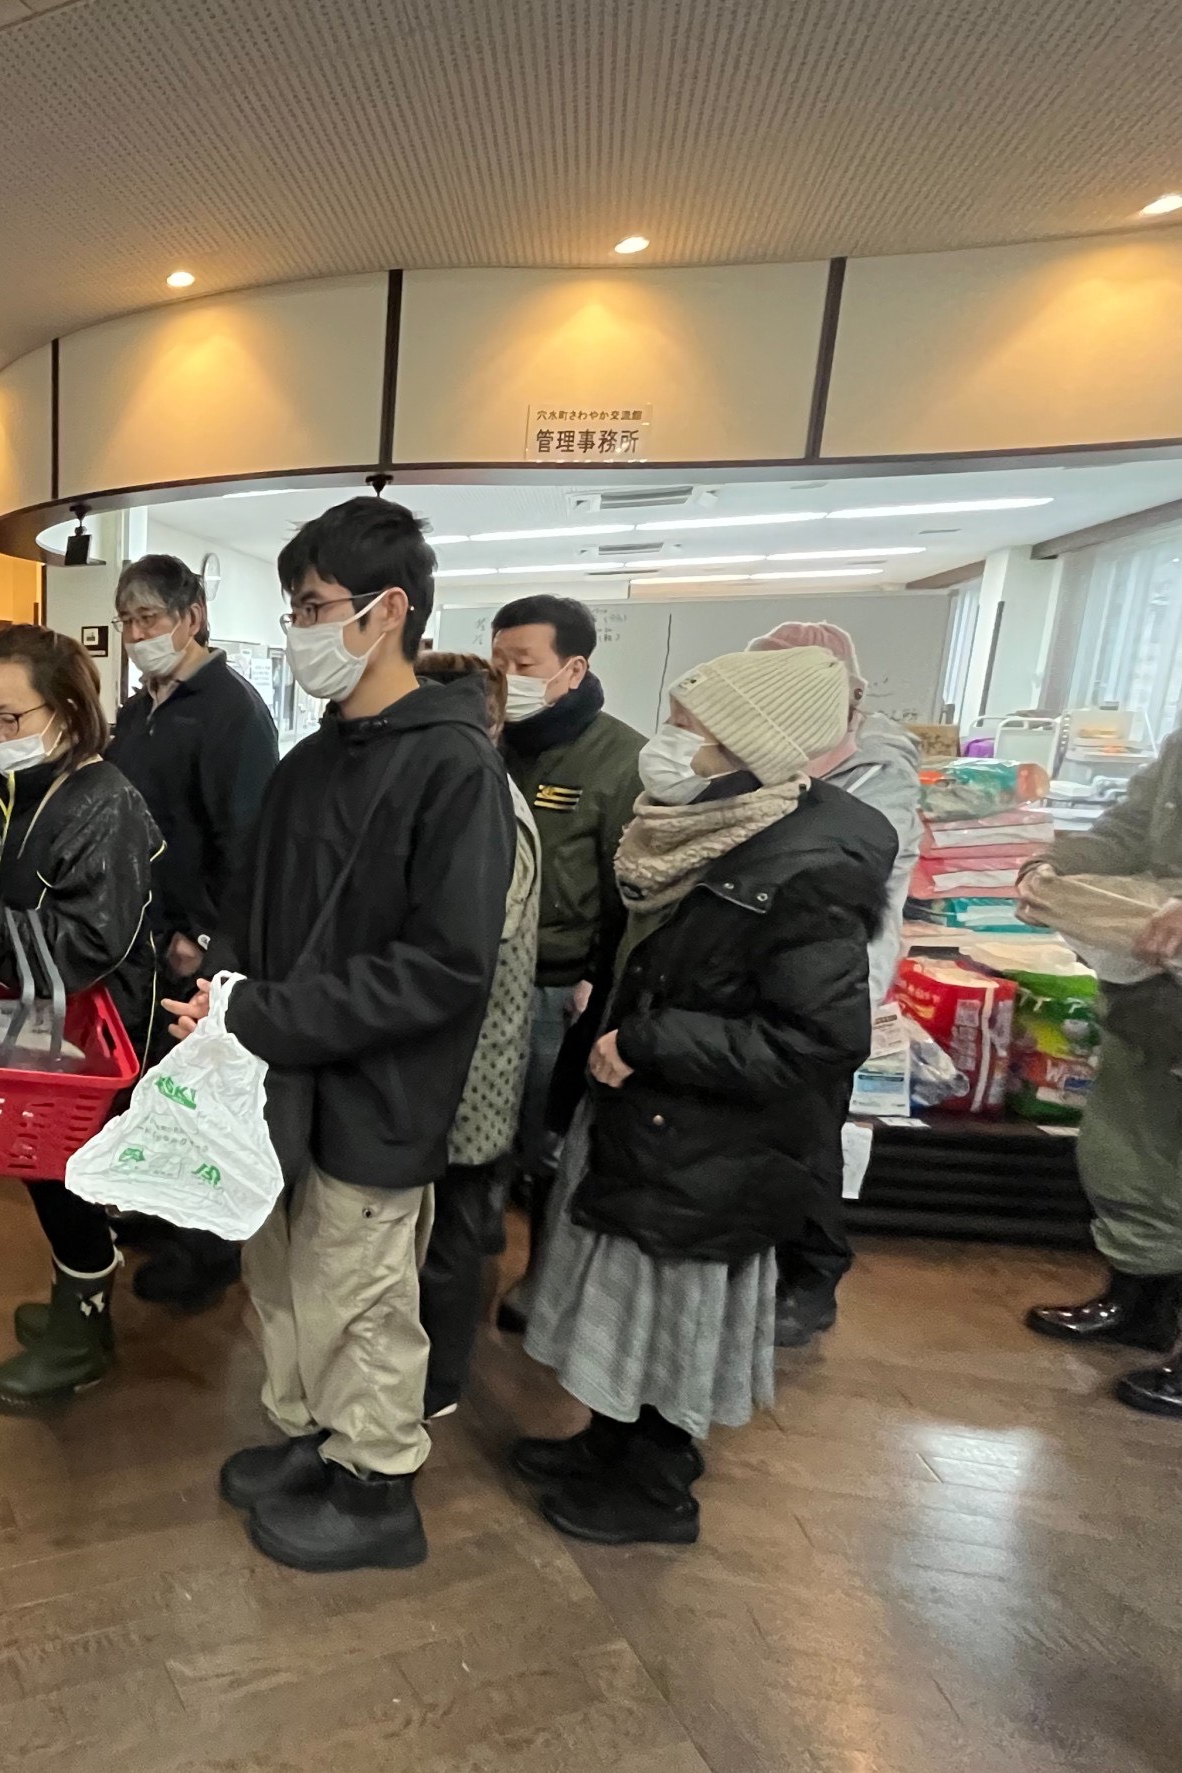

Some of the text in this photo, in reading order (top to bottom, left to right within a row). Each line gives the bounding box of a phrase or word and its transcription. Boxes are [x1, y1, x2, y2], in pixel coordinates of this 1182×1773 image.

[536, 410, 643, 421] 穴水町さわやか交流館
[536, 428, 640, 453] 管理事務所
